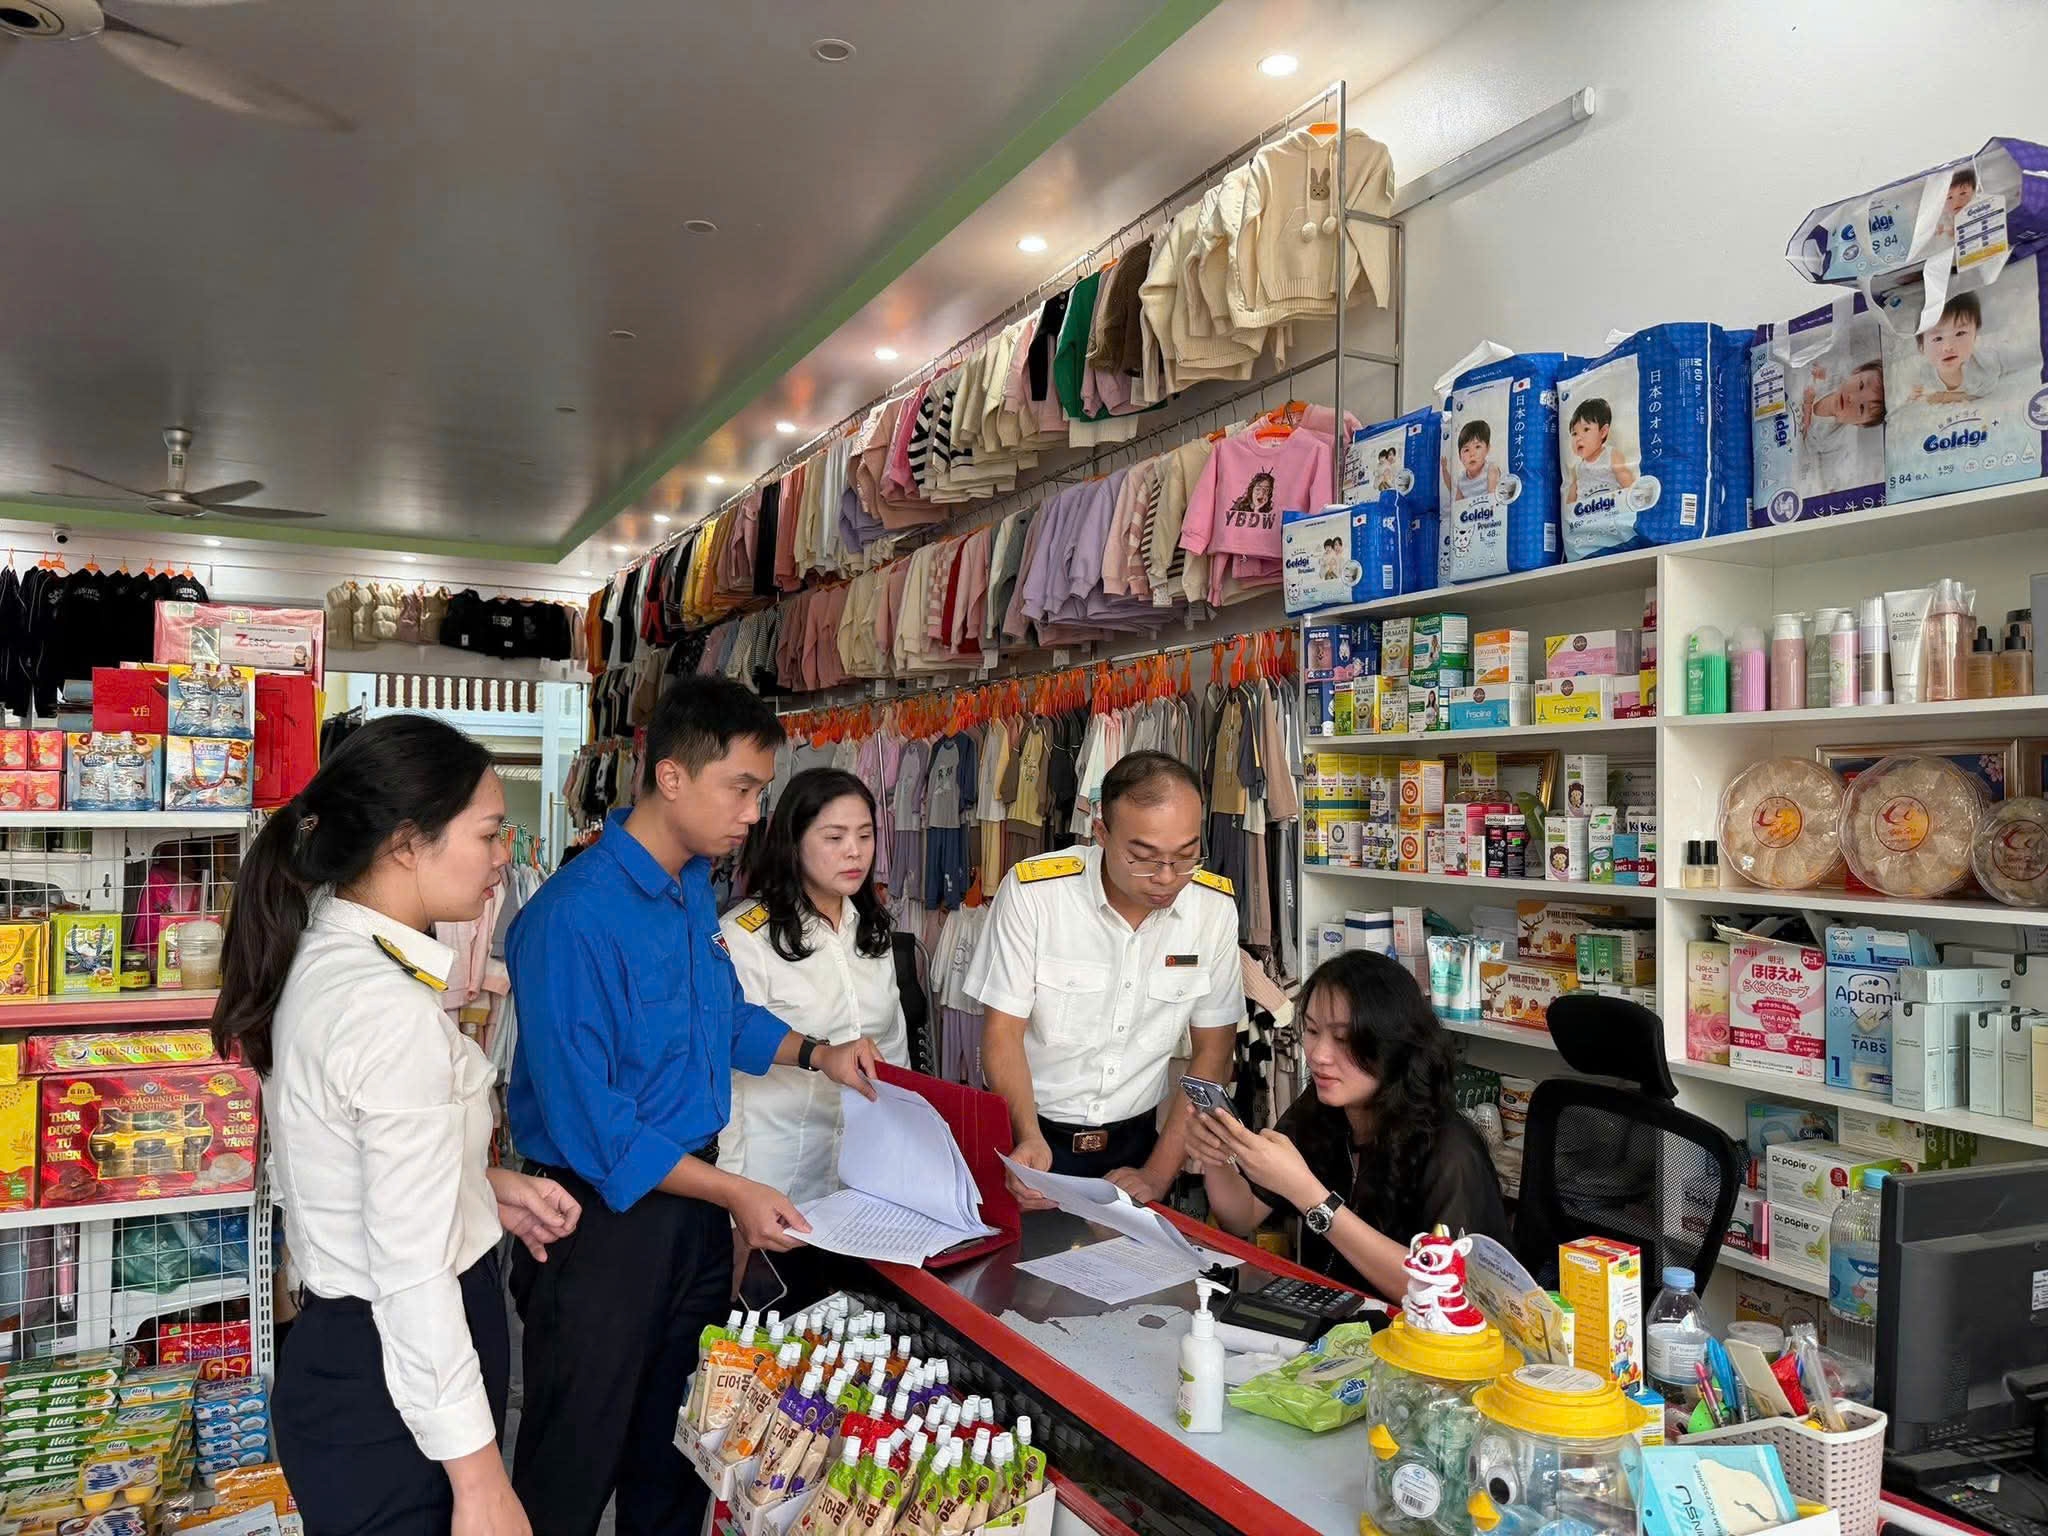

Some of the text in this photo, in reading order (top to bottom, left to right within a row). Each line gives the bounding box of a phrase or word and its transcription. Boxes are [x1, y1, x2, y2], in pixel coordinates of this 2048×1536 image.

[1884, 234, 1898, 247] 84
[1649, 369, 1662, 458] 日本のオムツ
[1514, 395, 1525, 471] 日本のオムツ
[1923, 425, 1989, 454] Goldgi
[1899, 474, 1912, 485] 84
[1574, 495, 1615, 516] Goldgi
[1225, 511, 1276, 530] YBDW
[1460, 506, 1493, 523] Goldgi
[131, 704, 150, 717] YẾ
[1734, 948, 1758, 957] meiji
[1831, 953, 1856, 962] TABS
[1866, 948, 1875, 964] 1
[1767, 955, 1785, 965] 明治
[1751, 964, 1803, 983] ほほえみ
[1742, 978, 1810, 999] らくらくキューブ
[1835, 984, 1902, 1007] Aptamil
[1851, 1040, 1887, 1054] TABS
[1831, 1056, 1840, 1077] 1
[1782, 1158, 1807, 1170] papie
[1784, 1216, 1809, 1230] papie
[51, 1376, 80, 1387] Hoff
[49, 1396, 79, 1406] Hoff
[48, 1416, 77, 1427] Hoff
[48, 1436, 78, 1446] Hoff
[48, 1454, 75, 1465] Hoff
[856, 1500, 881, 1528] 어팡
